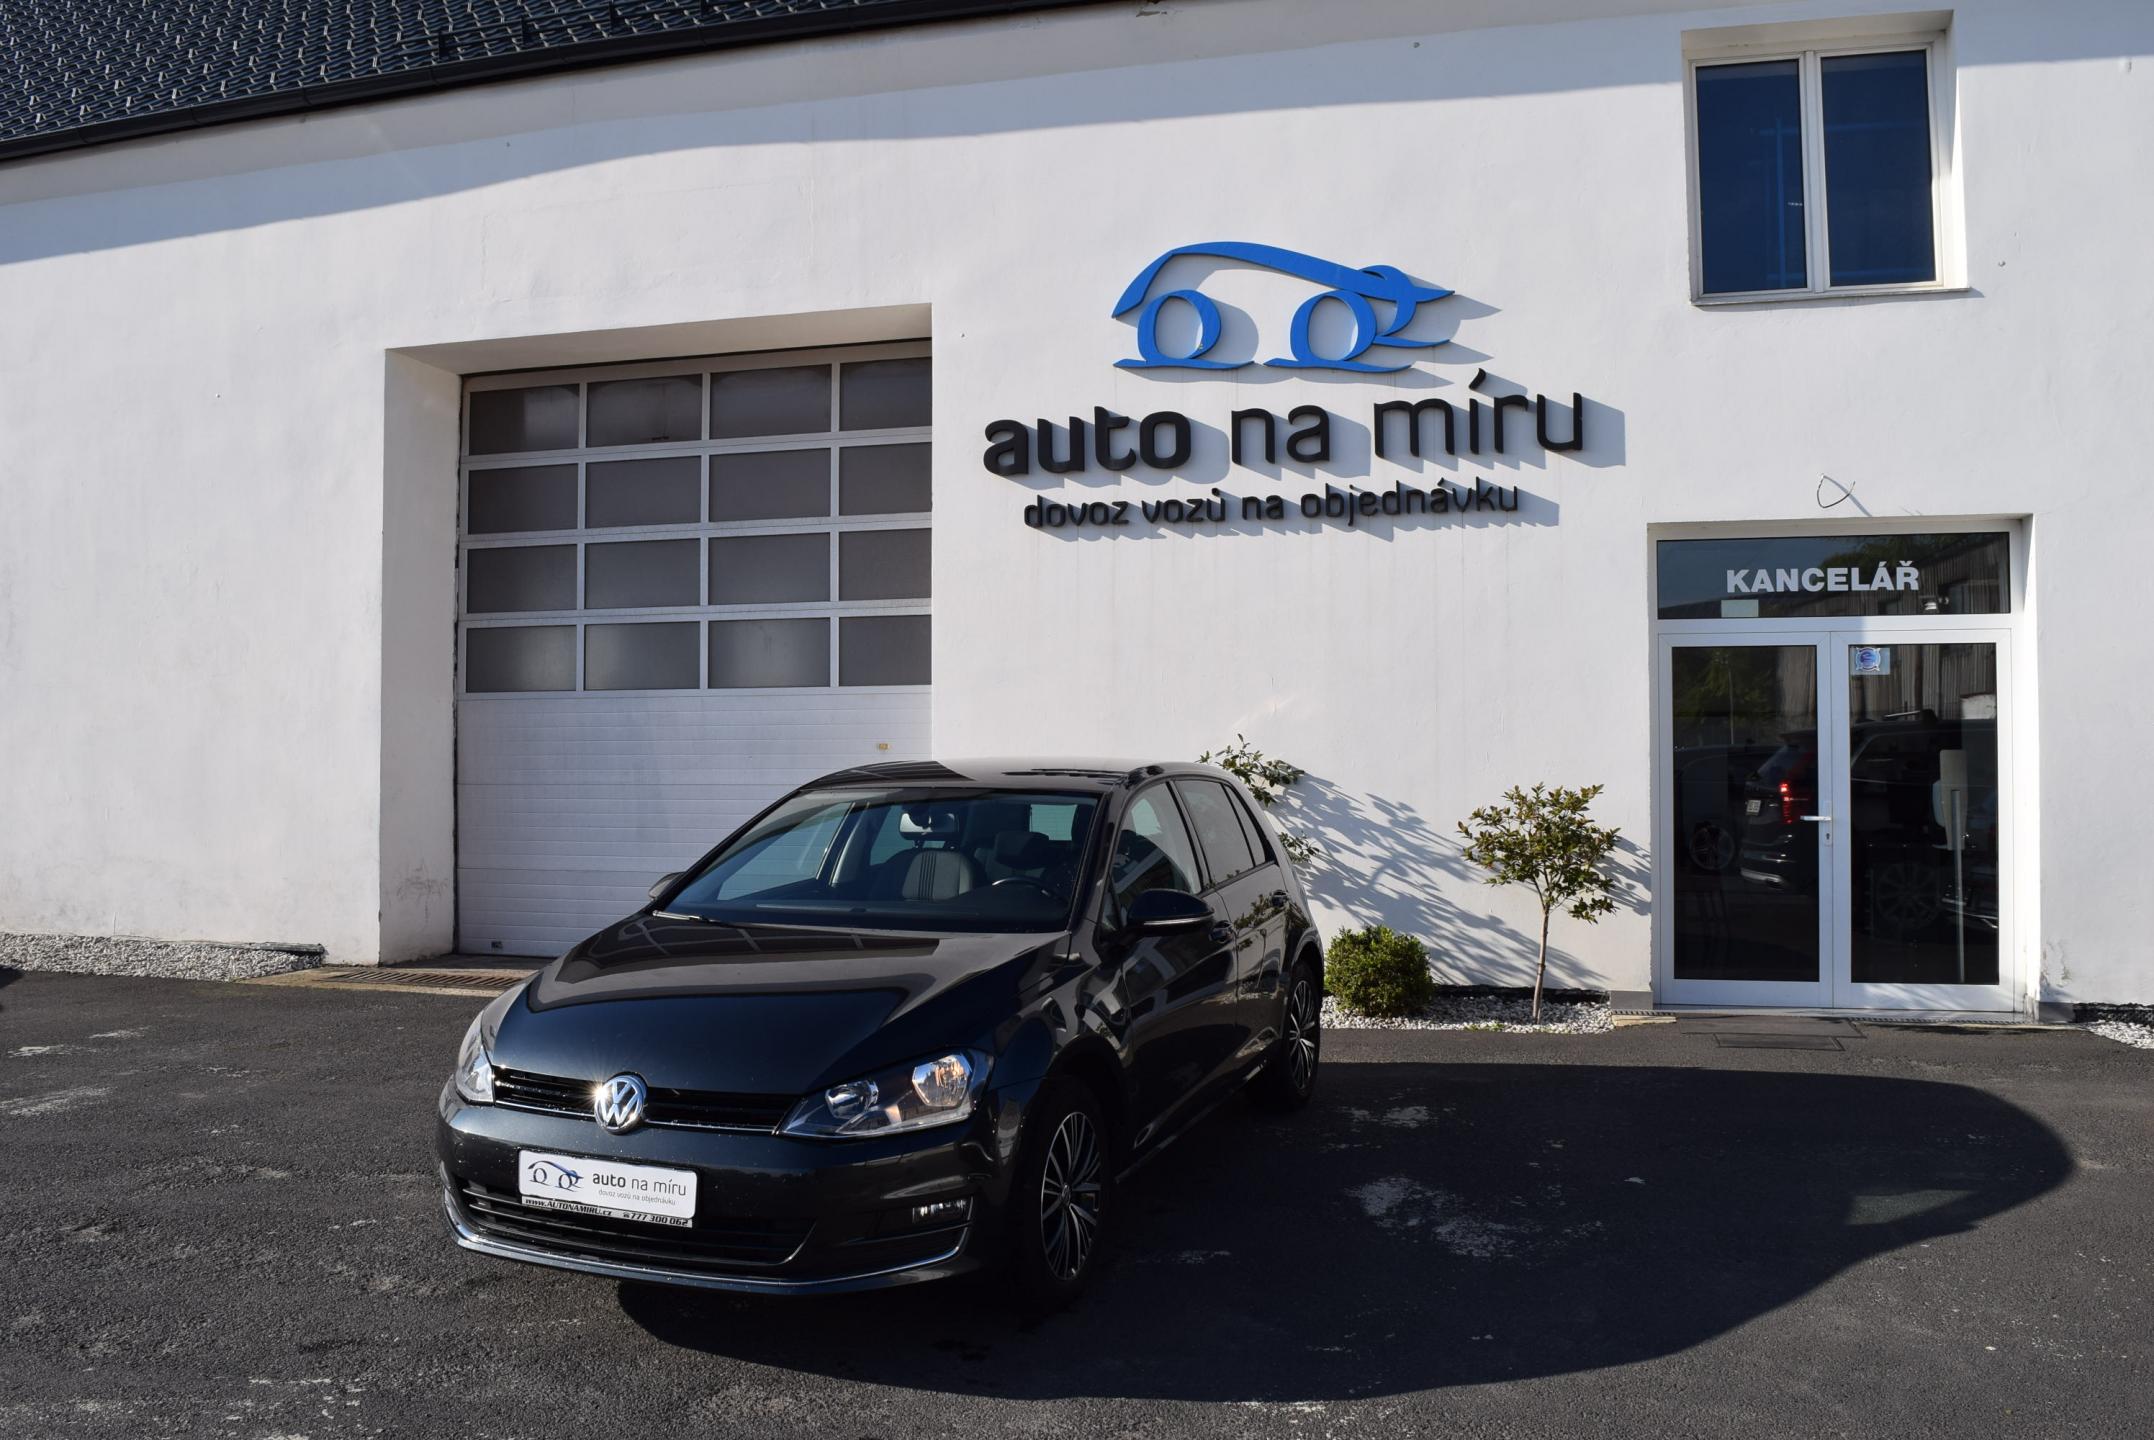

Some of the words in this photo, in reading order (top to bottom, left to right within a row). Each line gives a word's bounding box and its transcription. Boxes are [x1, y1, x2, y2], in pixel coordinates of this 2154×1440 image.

[983, 405, 1192, 477] auto
[1231, 404, 1330, 465] na
[1373, 368, 1584, 459] míru
[1023, 495, 1130, 529] dovoz
[1141, 488, 1226, 526] vozů
[1241, 492, 1285, 520] na
[1300, 477, 1519, 527] objednávku
[1726, 560, 1919, 593] KANCELÁŘ
[592, 1172, 626, 1189] auto
[631, 1178, 648, 1191] na
[653, 1178, 687, 1197] míru
